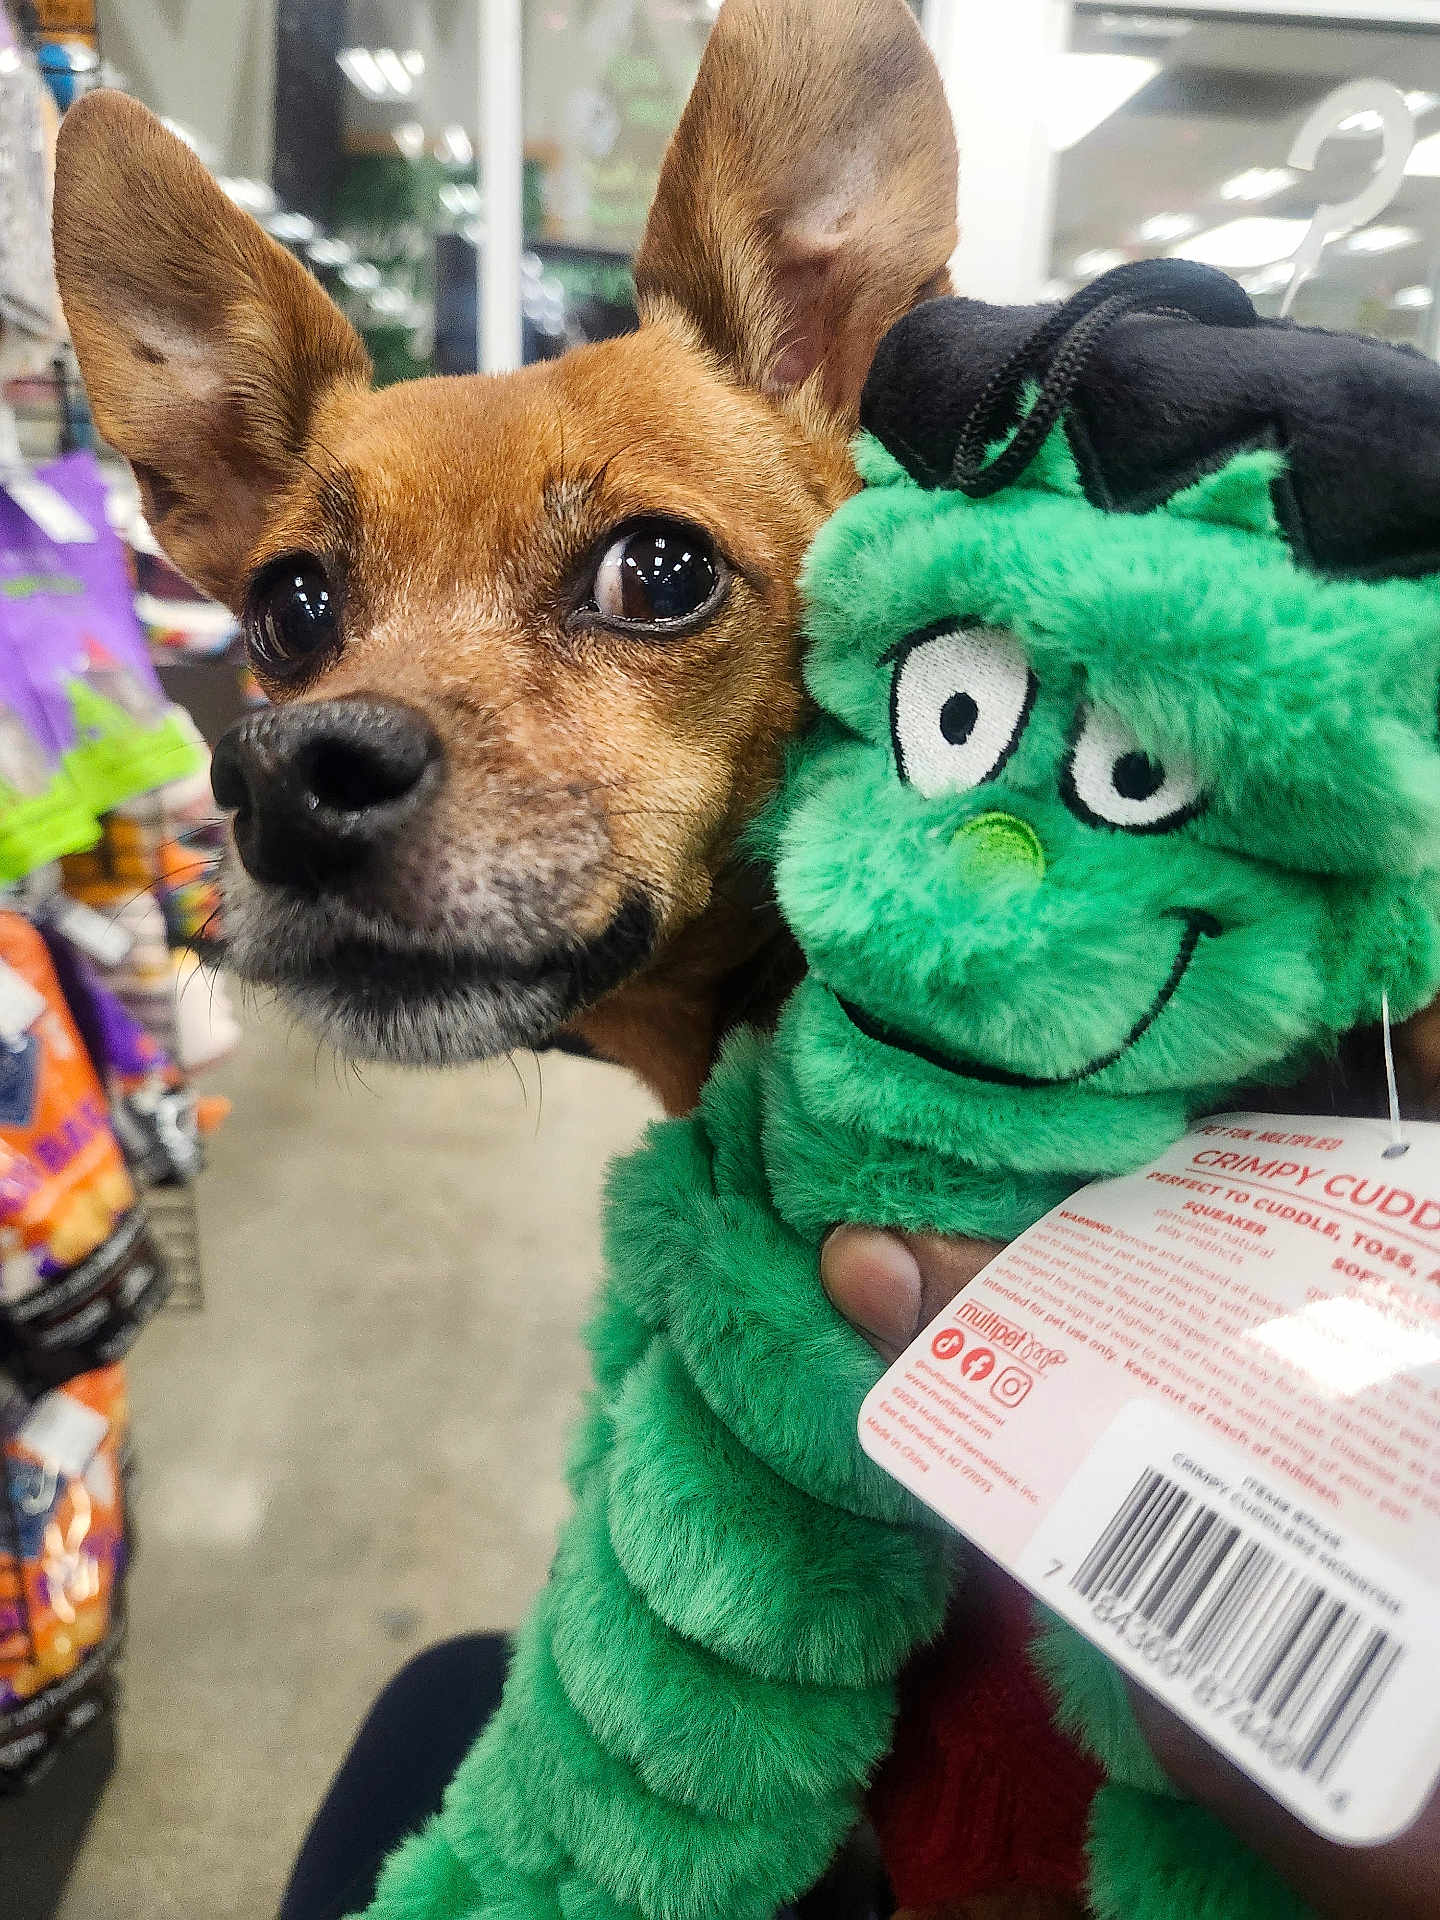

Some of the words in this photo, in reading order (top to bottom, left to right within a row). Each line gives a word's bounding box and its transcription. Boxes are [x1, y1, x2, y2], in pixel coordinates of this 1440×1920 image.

[1192, 1150, 1327, 1187] CRIMPY
[1145, 1171, 1223, 1195] PERFECT
[1224, 1189, 1251, 1203] TO
[1252, 1199, 1342, 1242] CUDDLE,
[1352, 1231, 1417, 1276] TOSS,
[1182, 1200, 1268, 1237] SQUEAKER
[1113, 1248, 1136, 1265] pet
[1135, 1258, 1169, 1278] when
[1168, 1273, 1217, 1304] playing
[1219, 1298, 1250, 1321] with
[1157, 1246, 1184, 1264] and
[1182, 1258, 1232, 1287] discard
[1007, 1254, 1055, 1281] damaged
[1053, 1271, 1077, 1293] toys
[1075, 1288, 1104, 1307] pose
[1116, 1308, 1156, 1336] higher
[1122, 1270, 1150, 1289] part
[1149, 1283, 1164, 1297] of
[1163, 1288, 1187, 1306] the
[955, 1302, 1028, 1351] multipet
[1168, 1315, 1220, 1350] inspect
[982, 1276, 1031, 1310] Intended
[1029, 1302, 1046, 1317] for
[1044, 1313, 1066, 1329] pet
[1066, 1325, 1089, 1343] use
[1123, 1358, 1159, 1388] Keep
[1161, 1384, 1186, 1402] out
[1187, 1400, 1207, 1415] of
[1206, 1412, 1249, 1445] reach
[1252, 1442, 1273, 1457] of
[880, 1400, 899, 1418] East
[905, 1371, 992, 1440] www.multipet.com
[918, 1406, 954, 1437] Multipet
[866, 1416, 891, 1440] Made
[890, 1438, 901, 1449] in
[901, 1446, 931, 1472] China
[1172, 1452, 1231, 1495] CRIMPY
[1043, 1558, 1064, 1579] 7
